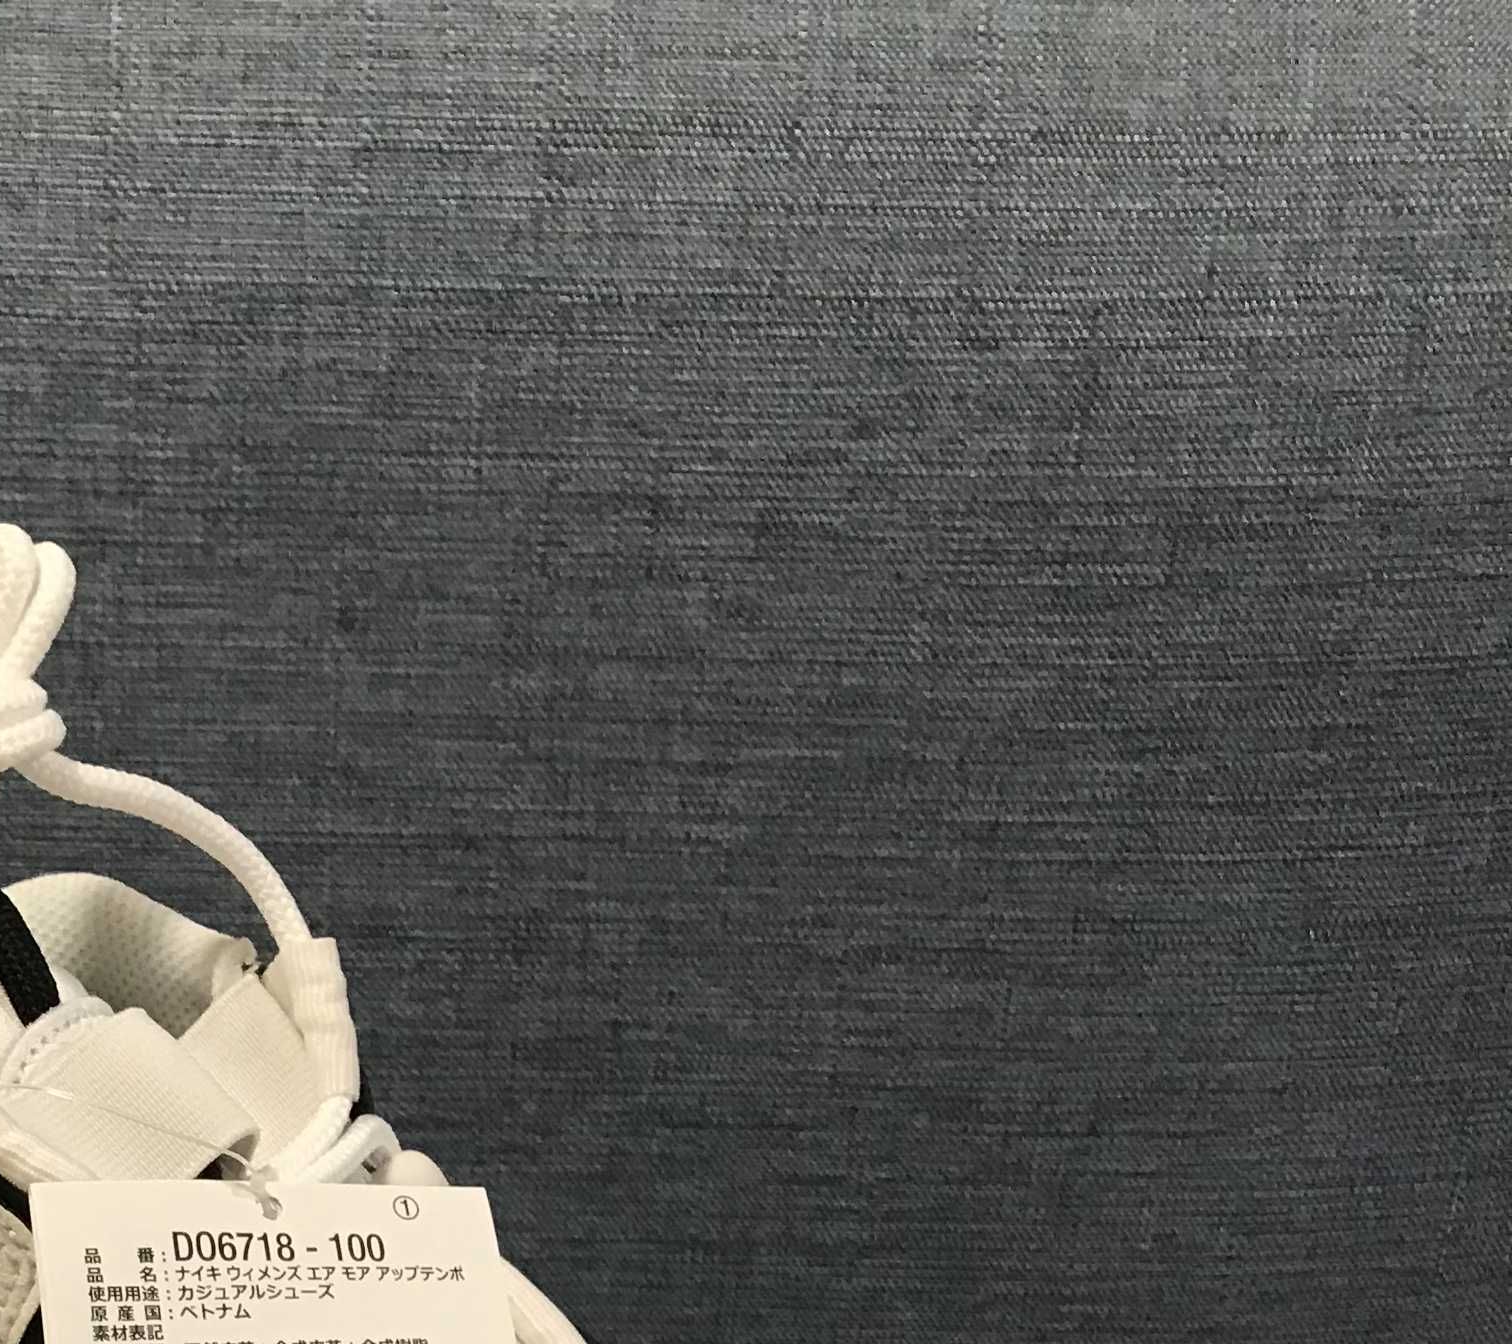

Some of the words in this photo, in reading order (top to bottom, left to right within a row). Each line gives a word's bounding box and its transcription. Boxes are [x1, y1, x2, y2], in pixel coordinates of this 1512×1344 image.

[328, 1233, 385, 1262] 100
[92, 1324, 164, 1341] 素材表記
